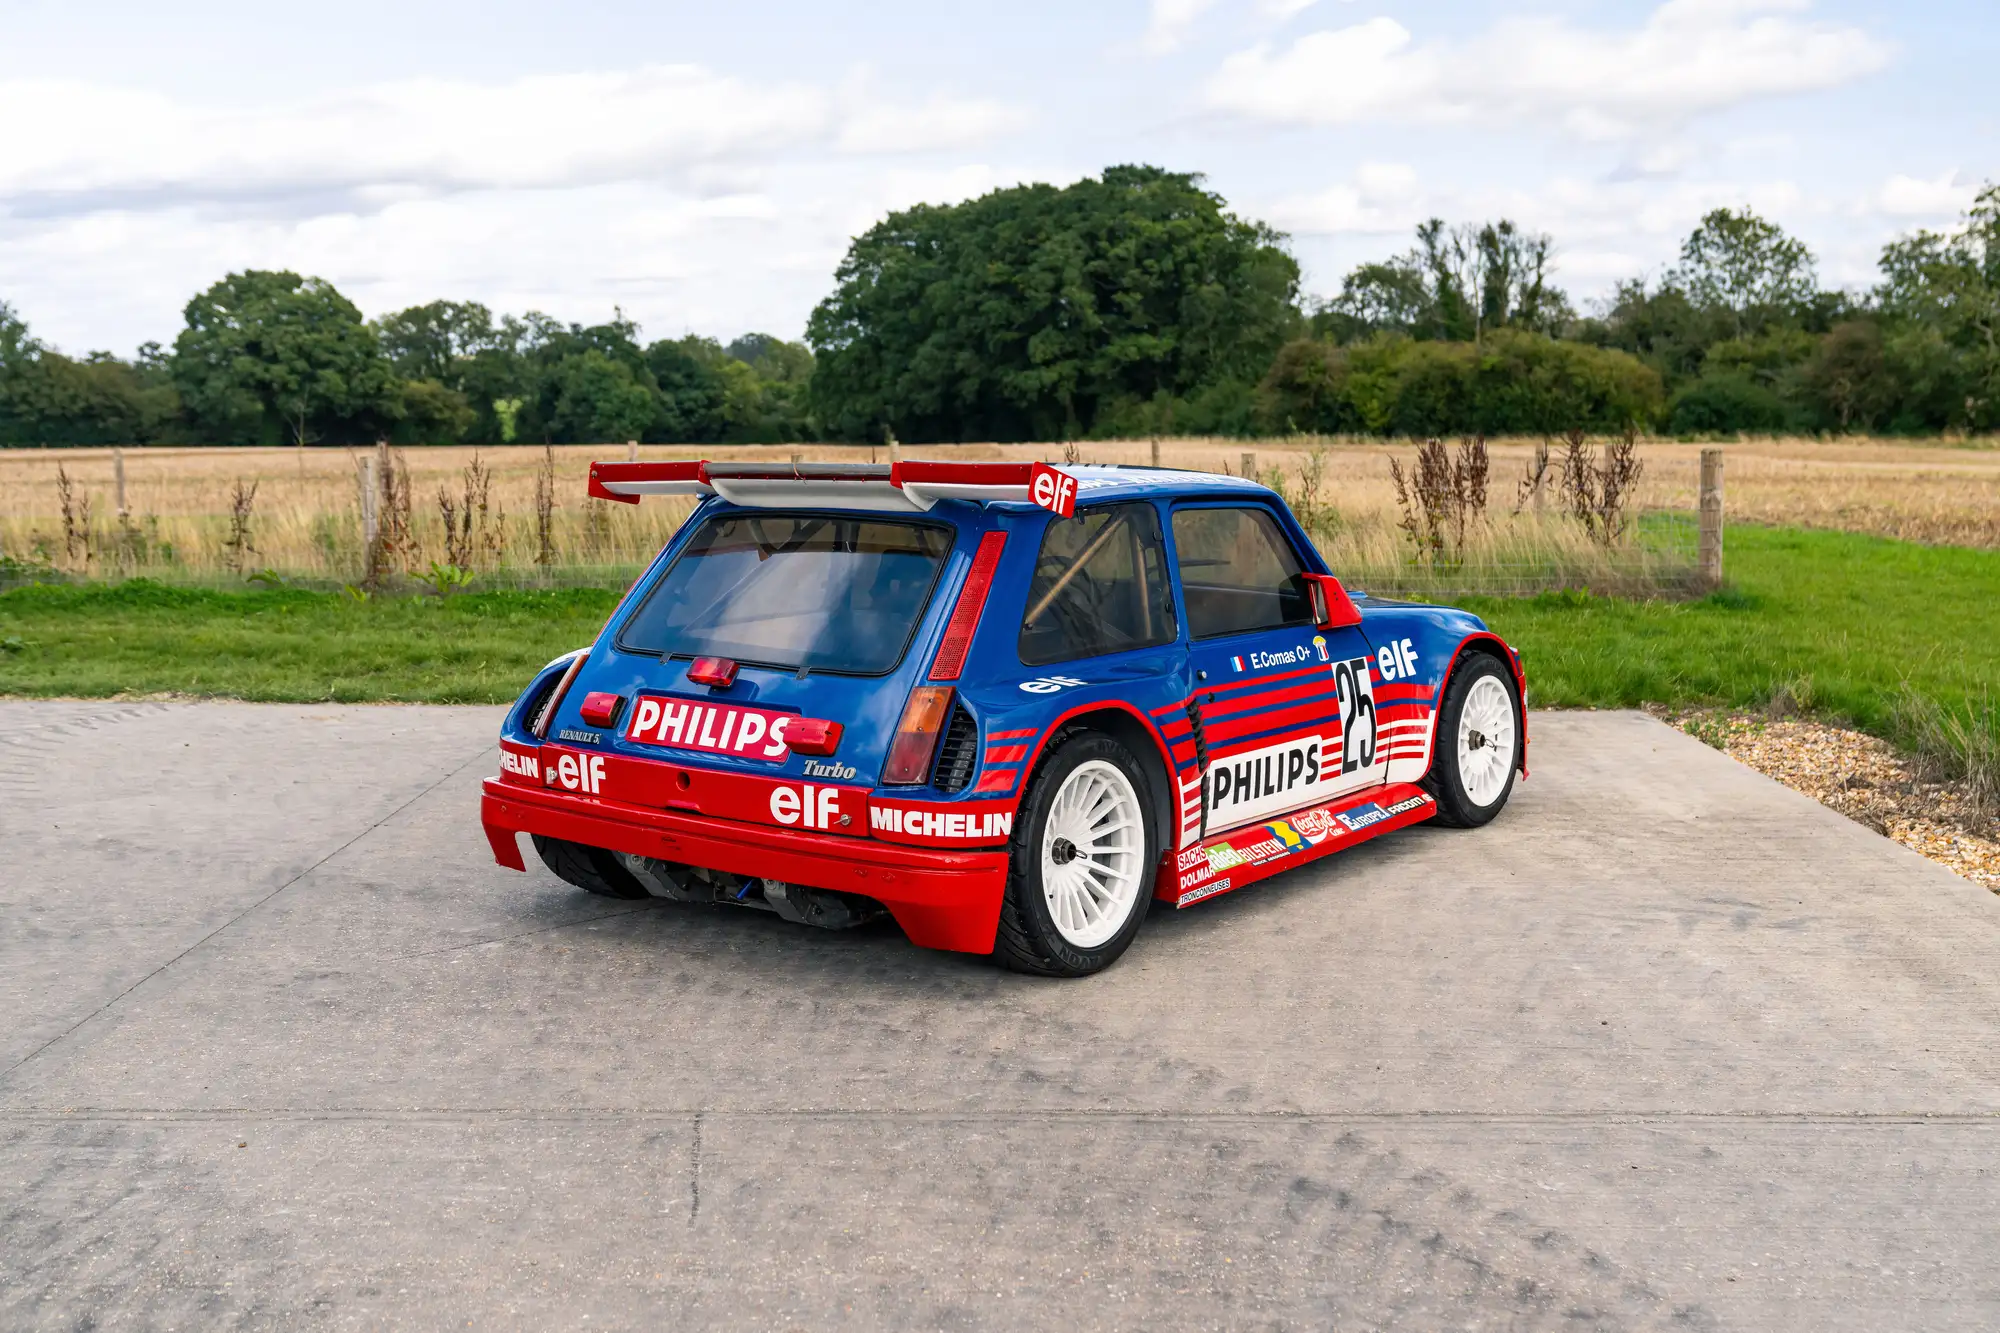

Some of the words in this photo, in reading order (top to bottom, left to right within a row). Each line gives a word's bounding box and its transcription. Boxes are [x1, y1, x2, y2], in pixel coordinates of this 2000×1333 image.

[1034, 472, 1073, 514] elf
[1250, 650, 1296, 669] E.Comas
[1296, 645, 1311, 661] O+
[1378, 638, 1418, 681] elf
[1019, 676, 1088, 694] elf
[631, 700, 788, 757] PHILIPS
[1335, 658, 1377, 774] 25
[559, 729, 594, 743] RENAULT
[558, 753, 606, 794] elf
[802, 759, 857, 780] Turbo
[1212, 743, 1320, 810] PHILIPS
[770, 784, 840, 829] elf
[1388, 796, 1425, 815] FACOM
[870, 806, 1013, 838] MICHELIN
[1291, 808, 1337, 836] Coca-Cola
[1329, 827, 1345, 837] Coke
[1179, 846, 1207, 869] SACHS
[1237, 838, 1287, 862] BILSTEIN
[1180, 864, 1216, 890] DOLMAR
